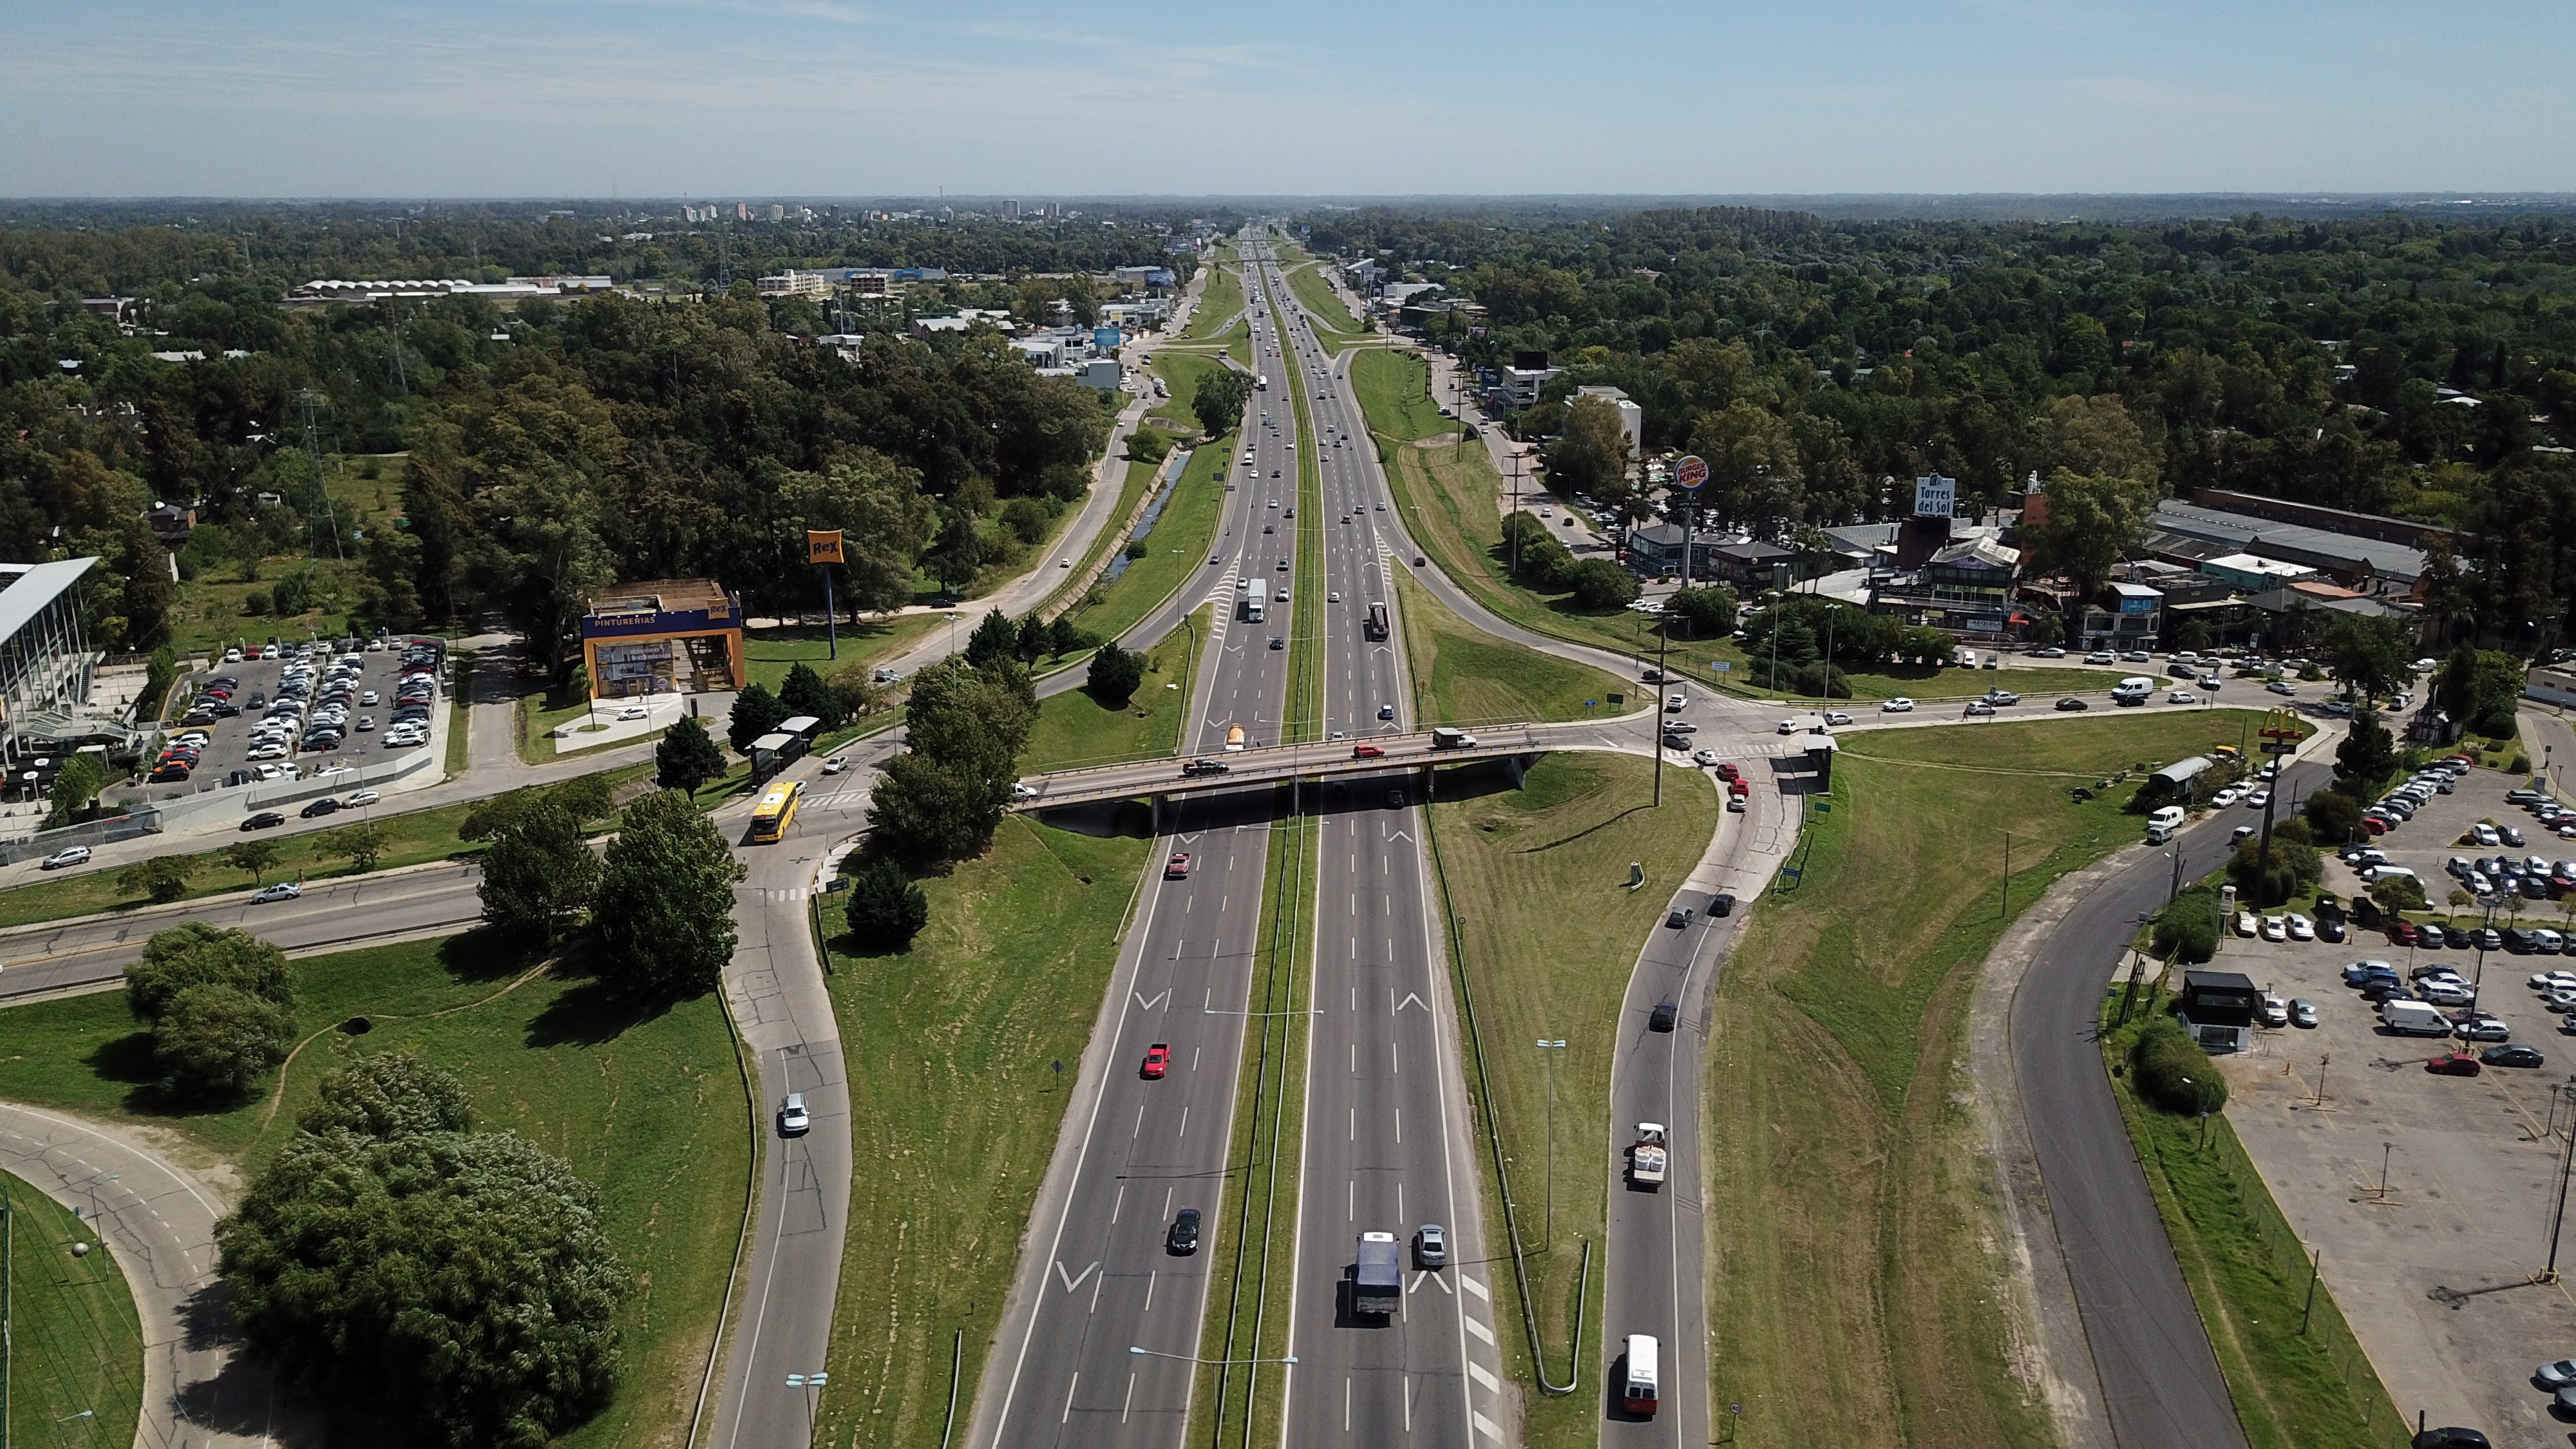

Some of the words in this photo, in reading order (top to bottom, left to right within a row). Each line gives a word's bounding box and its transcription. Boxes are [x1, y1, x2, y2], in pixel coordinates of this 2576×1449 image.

[1678, 462, 1705, 475] BURGER
[1678, 469, 1706, 484] KING
[1920, 486, 1950, 500] Torres
[1918, 500, 1933, 513] del
[1936, 501, 1950, 513] Sol
[813, 541, 838, 555] Rex
[710, 603, 727, 614] Rex
[594, 616, 656, 628] PINTURERIAS
